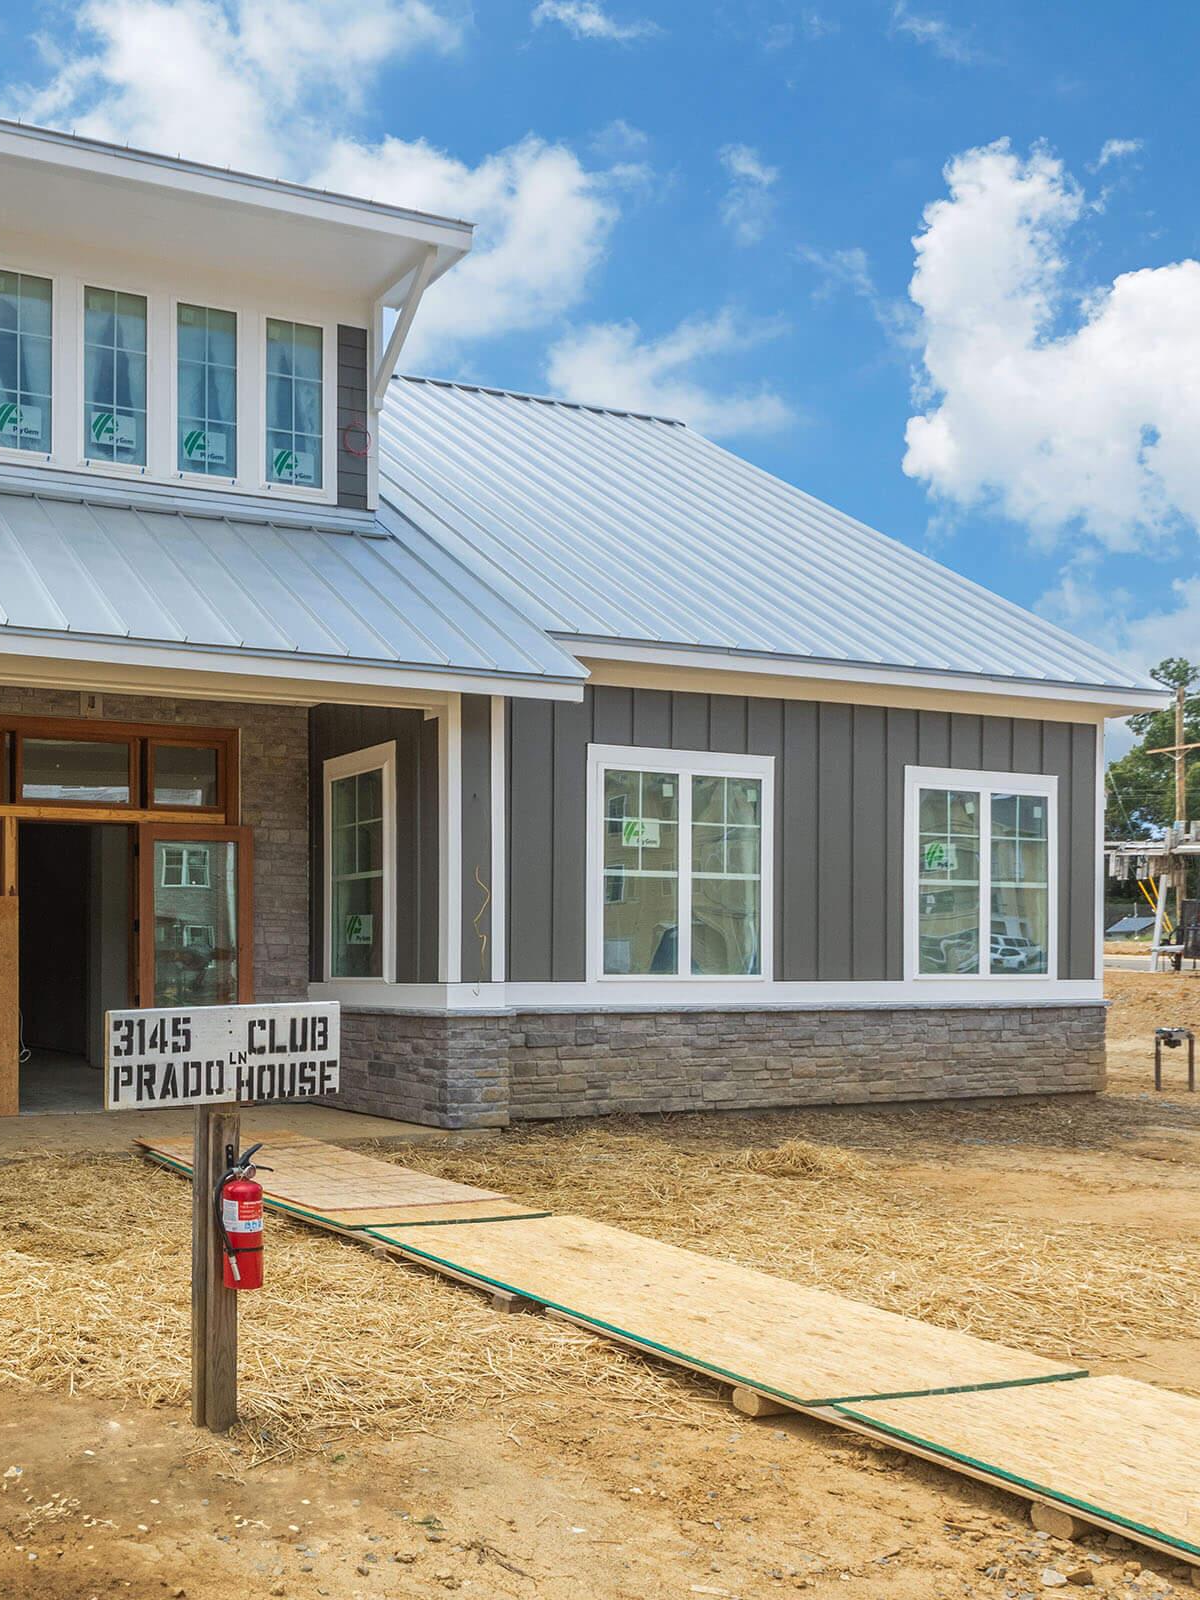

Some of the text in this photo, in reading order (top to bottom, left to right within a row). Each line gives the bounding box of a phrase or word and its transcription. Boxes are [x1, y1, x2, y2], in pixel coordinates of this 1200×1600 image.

[113, 1016, 192, 1057] 3145
[248, 1016, 328, 1055] CLUB
[112, 1051, 247, 1102] PRADO LN
[236, 1060, 338, 1101] HOUSE
